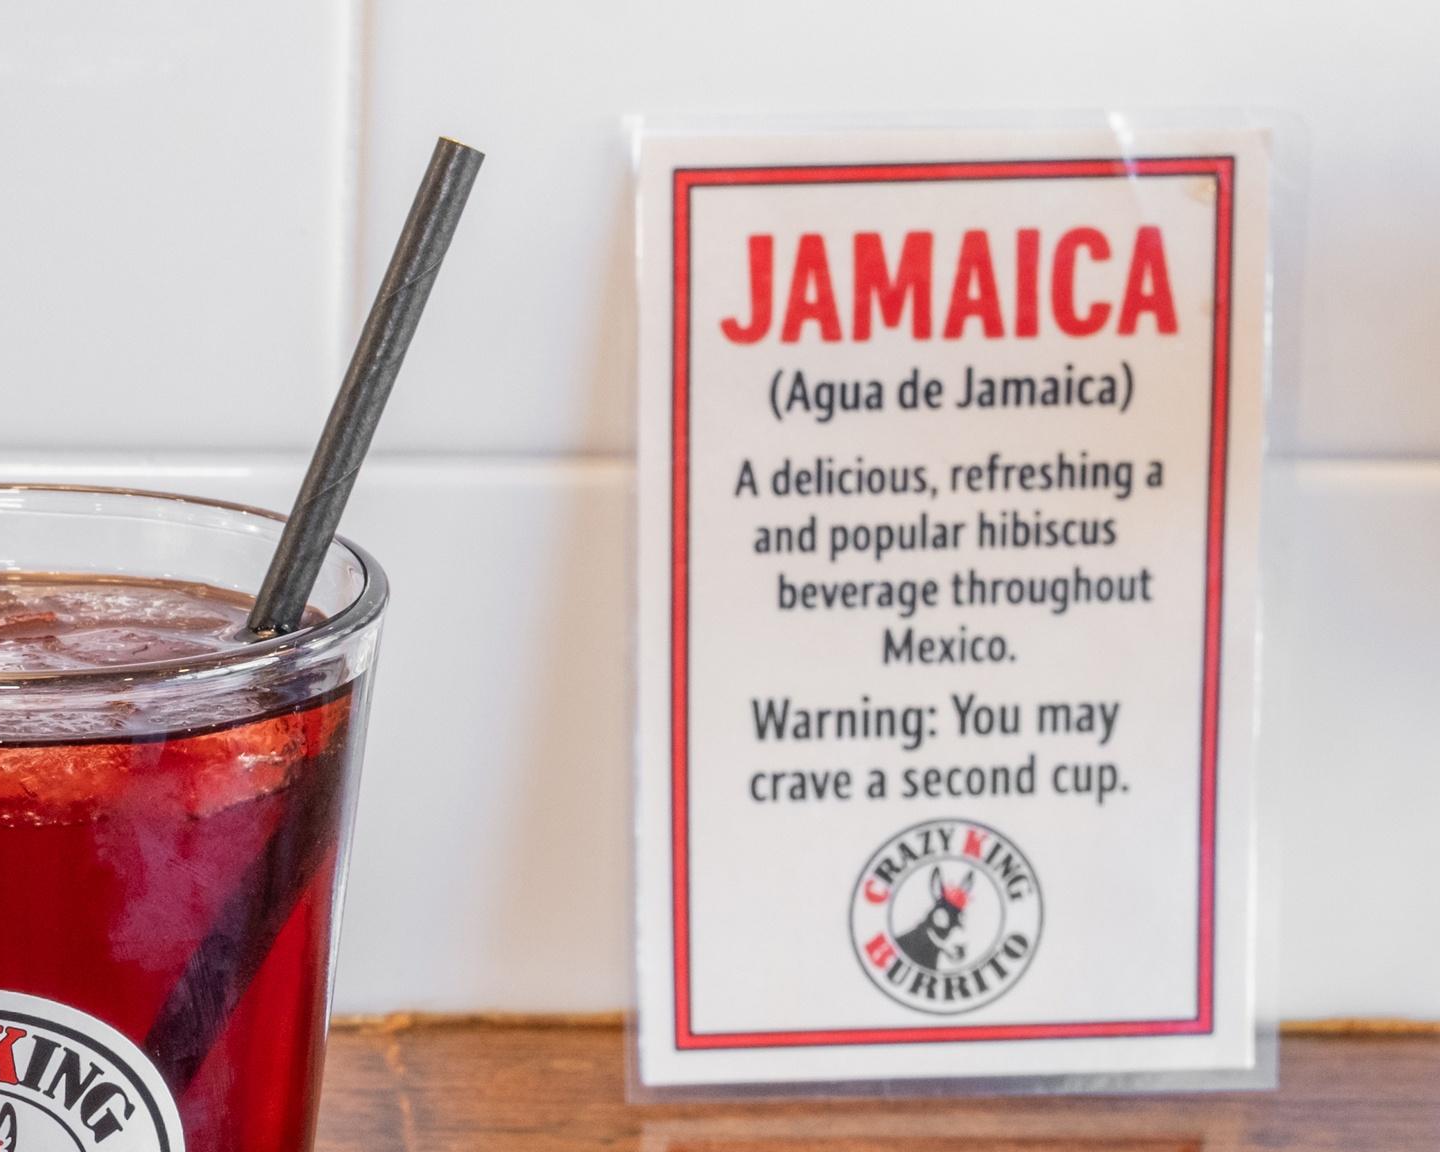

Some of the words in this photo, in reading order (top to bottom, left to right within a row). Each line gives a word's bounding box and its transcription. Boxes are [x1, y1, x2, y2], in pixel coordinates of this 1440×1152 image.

[719, 224, 1181, 347] JAMAICA
[768, 369, 885, 424] (Agua
[896, 367, 945, 410] de
[955, 360, 1136, 415] Jamaica)
[733, 458, 759, 498] A
[770, 456, 939, 500] delicious,
[950, 452, 1134, 501] refreshing
[1145, 459, 1165, 489] a
[753, 516, 818, 555] and
[829, 512, 967, 562] popular
[977, 510, 1118, 549] hibiscus
[777, 573, 940, 618] beverage
[950, 568, 1153, 616] throughout
[882, 625, 1016, 665] Mexico.
[750, 696, 937, 751] Warning:
[950, 693, 1021, 737] You
[1037, 701, 1121, 746] may
[749, 769, 852, 803] crave
[866, 768, 887, 800] a
[901, 753, 1037, 800] second
[1051, 763, 1129, 806] cup.
[863, 827, 957, 906] CRAZY
[960, 827, 1034, 902] KING
[864, 931, 1031, 1002] BURRITO
